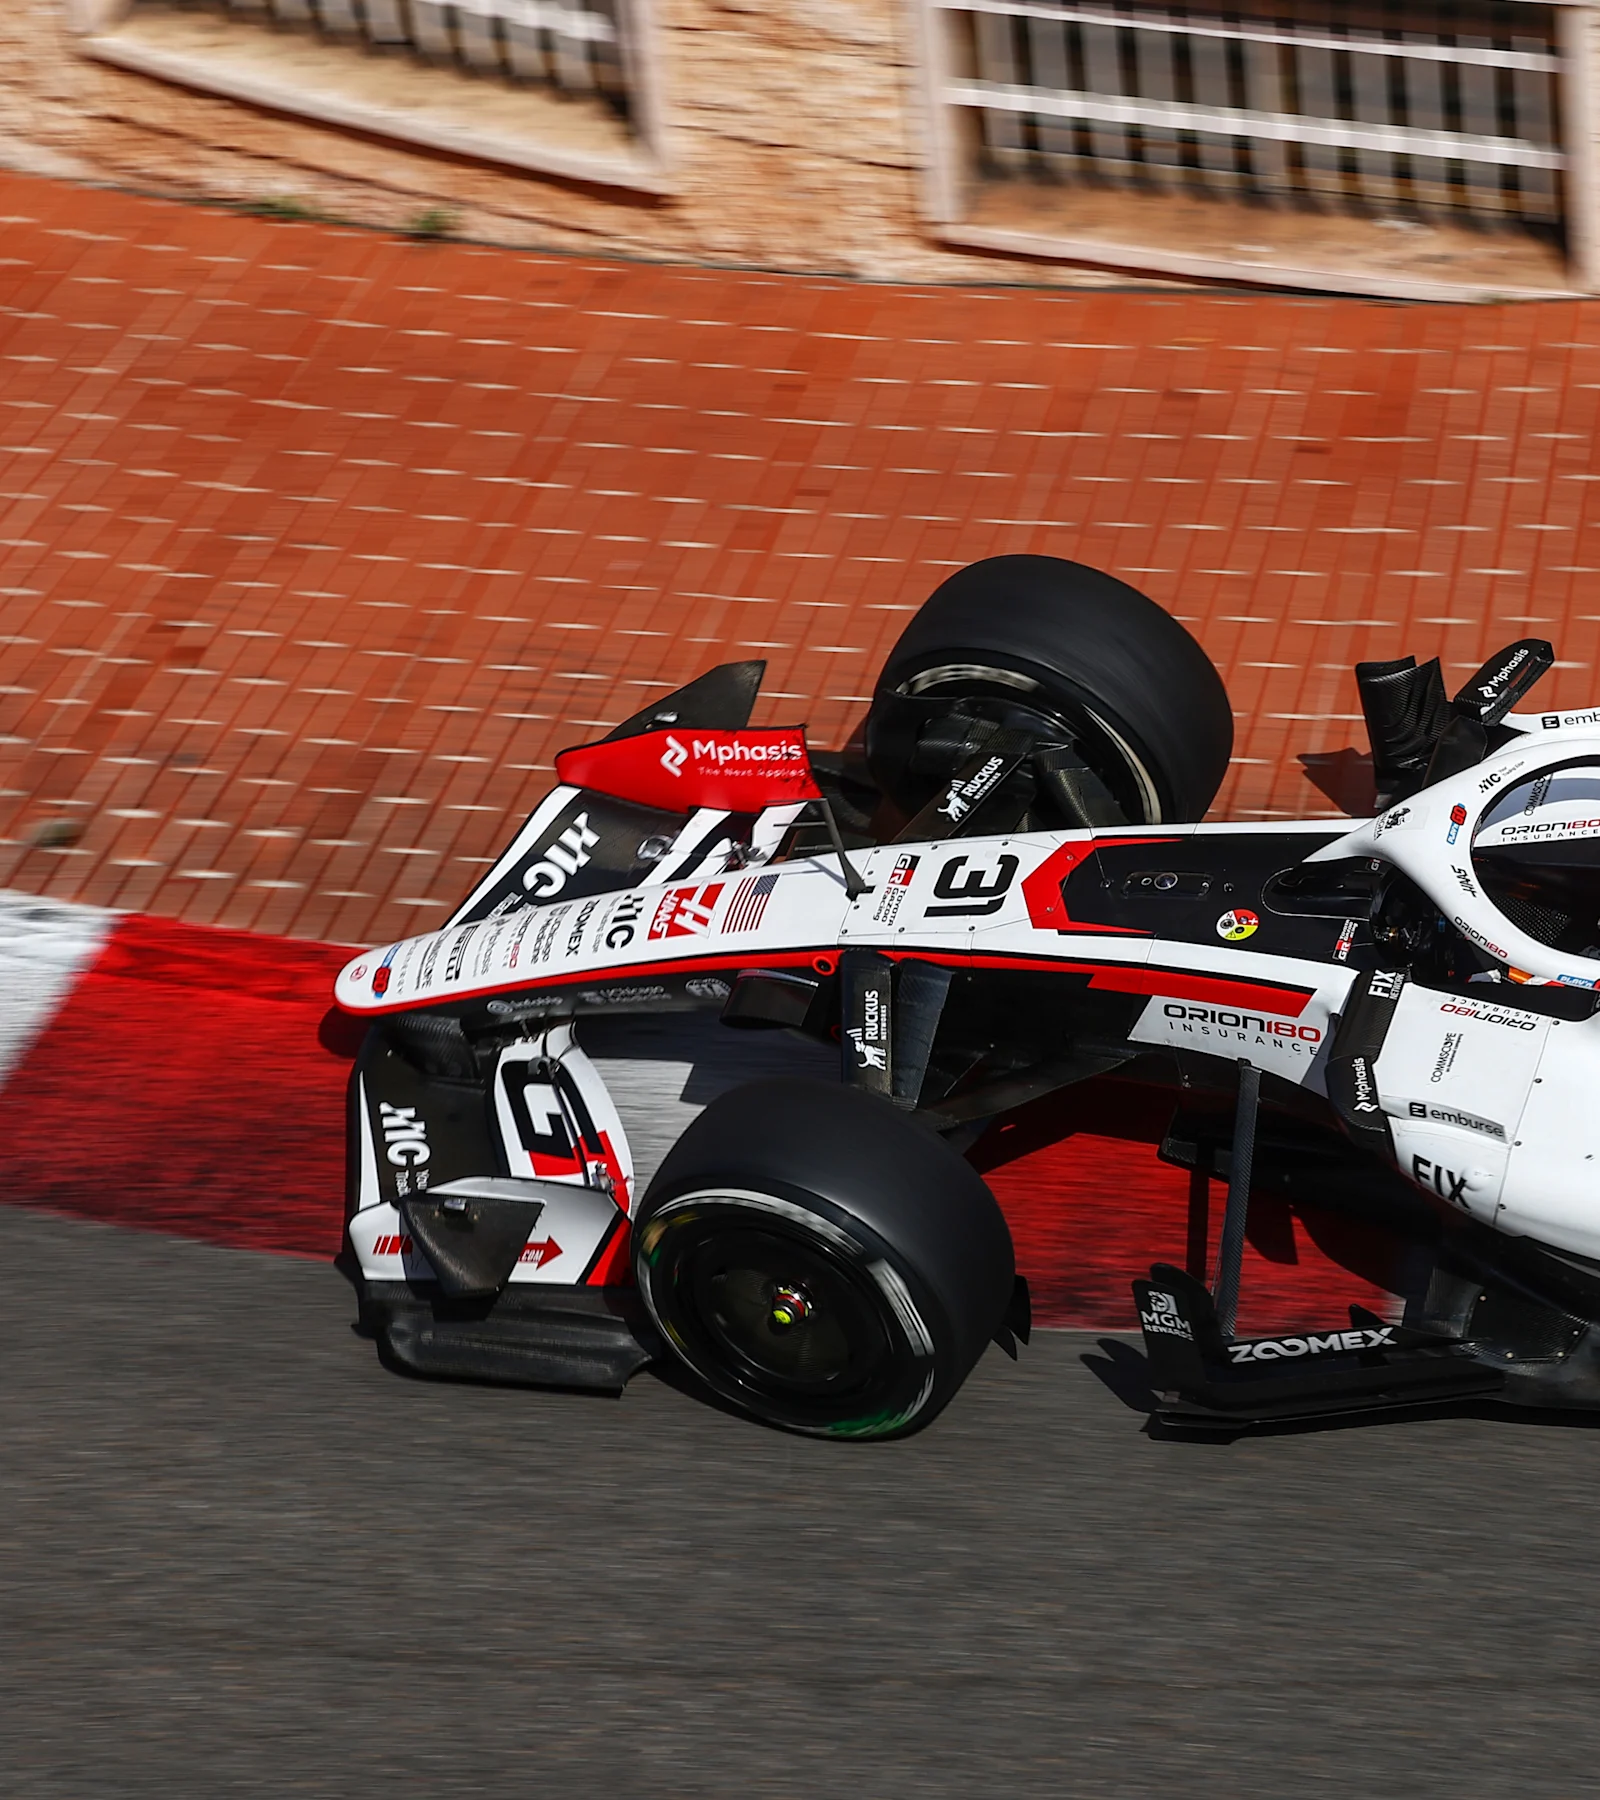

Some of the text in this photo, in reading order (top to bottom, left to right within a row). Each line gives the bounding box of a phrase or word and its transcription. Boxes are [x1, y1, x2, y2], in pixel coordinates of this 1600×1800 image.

[1490, 647, 1529, 688] Mphasis
[692, 739, 803, 766] Mphasis
[961, 756, 1004, 797] RUCKUS
[1502, 828, 1599, 842] INSURANCE
[889, 854, 912, 885] GR
[923, 854, 1020, 918] 31
[653, 888, 678, 940] HAAS
[872, 886, 893, 921] Racing
[881, 887, 900, 923] GAZOO
[887, 888, 908, 927] TOYOTA
[565, 899, 600, 958] ZOOMEX
[1339, 919, 1351, 940] TOYOTA
[1454, 916, 1508, 959] ORION180
[1338, 941, 1351, 961] GR
[1368, 969, 1397, 998] FIX
[1388, 973, 1406, 1001] NETWORK
[865, 990, 879, 1041] RUCKUS
[1163, 1003, 1321, 1043] ORION180
[1439, 1003, 1538, 1031] ORION180
[1450, 997, 1540, 1021] INSURANCE
[1169, 1021, 1318, 1057] INSURANCE
[1430, 1032, 1457, 1082] COMMSCOPE
[1351, 1057, 1370, 1102] Mphasis
[1430, 1109, 1504, 1138] emburse
[1411, 1153, 1471, 1209] FIX
[1140, 1310, 1193, 1334] MGM
[1143, 1324, 1195, 1342] REWARDS
[1228, 1327, 1398, 1364] ZOOMEX
